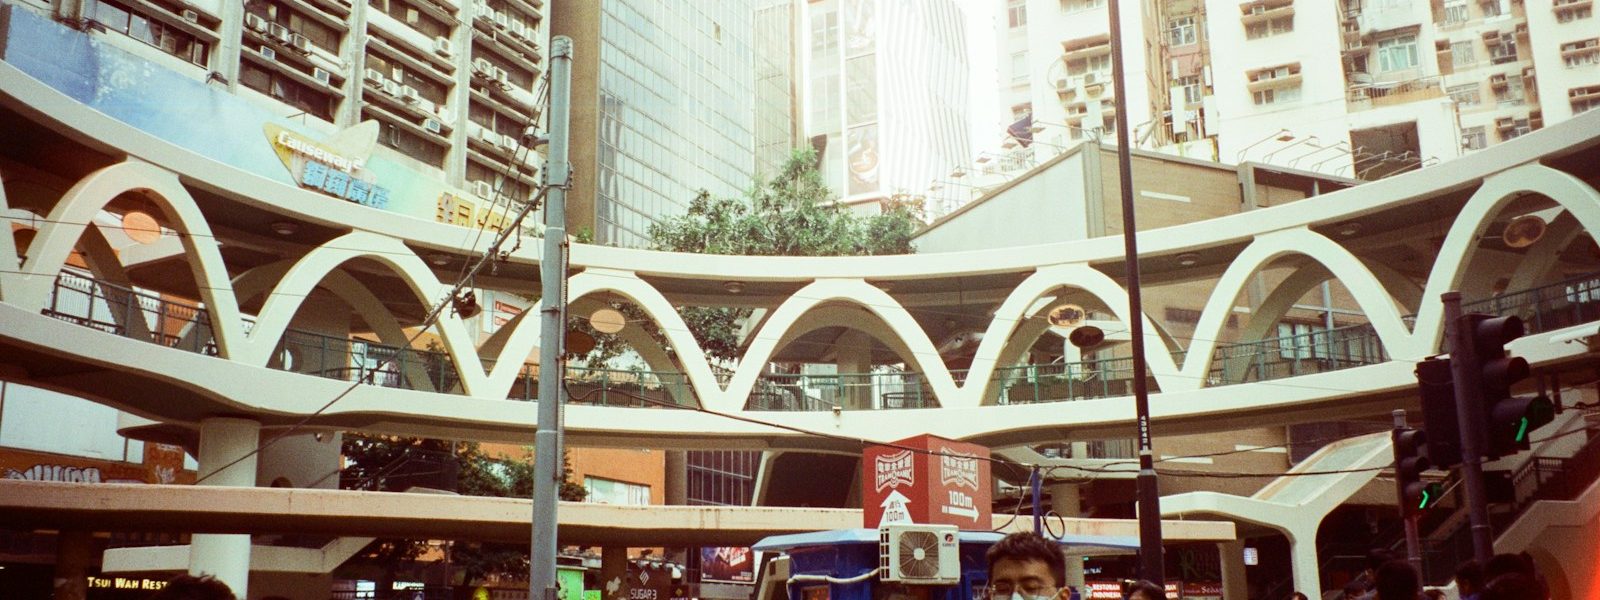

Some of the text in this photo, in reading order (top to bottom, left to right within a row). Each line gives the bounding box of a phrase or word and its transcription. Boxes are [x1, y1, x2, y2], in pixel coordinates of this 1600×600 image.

[948, 490, 973, 508] 100m
[886, 511, 905, 522] 100m
[115, 577, 139, 589] WAH
[630, 588, 652, 600] SUGAR
